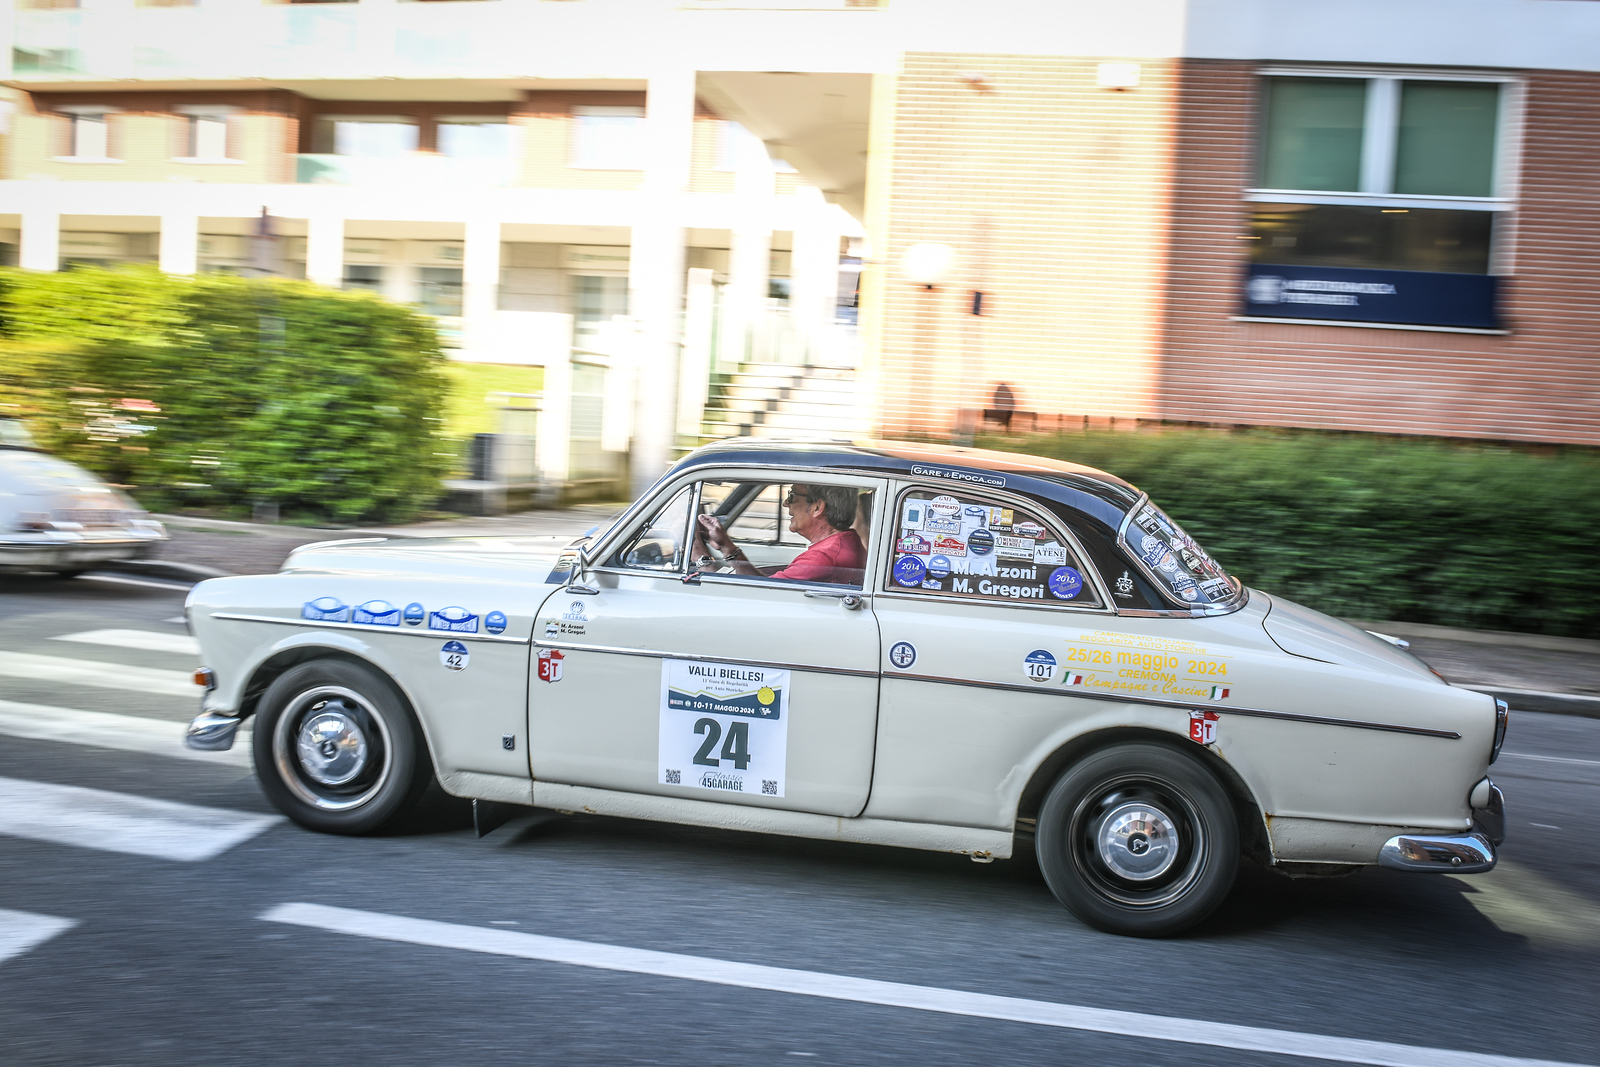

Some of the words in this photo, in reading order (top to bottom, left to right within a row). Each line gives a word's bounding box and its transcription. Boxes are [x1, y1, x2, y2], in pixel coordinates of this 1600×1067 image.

[913, 467, 942, 477] GARE
[996, 537, 1002, 545] 10
[976, 562, 1037, 580] Arzoni
[1056, 574, 1076, 584] 2015
[952, 578, 974, 593] M.
[979, 580, 1044, 599] Gregori
[1093, 630, 1153, 642] CAMPIONATO
[1154, 638, 1196, 647] ITALIANO
[1138, 640, 1162, 649] AUTO
[1164, 644, 1207, 654] STORICHE
[446, 654, 462, 666] 42
[1068, 648, 1112, 664] 25/26
[1116, 651, 1179, 671] maggio
[1188, 660, 1228, 676] 2024
[542, 662, 558, 677] 3T
[688, 666, 716, 677] VALLI
[720, 668, 764, 682] BIELLESI
[1028, 664, 1052, 677] 101
[1118, 669, 1177, 683] CREMONA
[1084, 674, 1151, 693] Campagne
[1162, 681, 1208, 697] Cascine
[693, 702, 713, 710] 10-11
[714, 704, 739, 712] MAGGIO
[1194, 722, 1212, 739] 3T
[693, 718, 751, 770] 24
